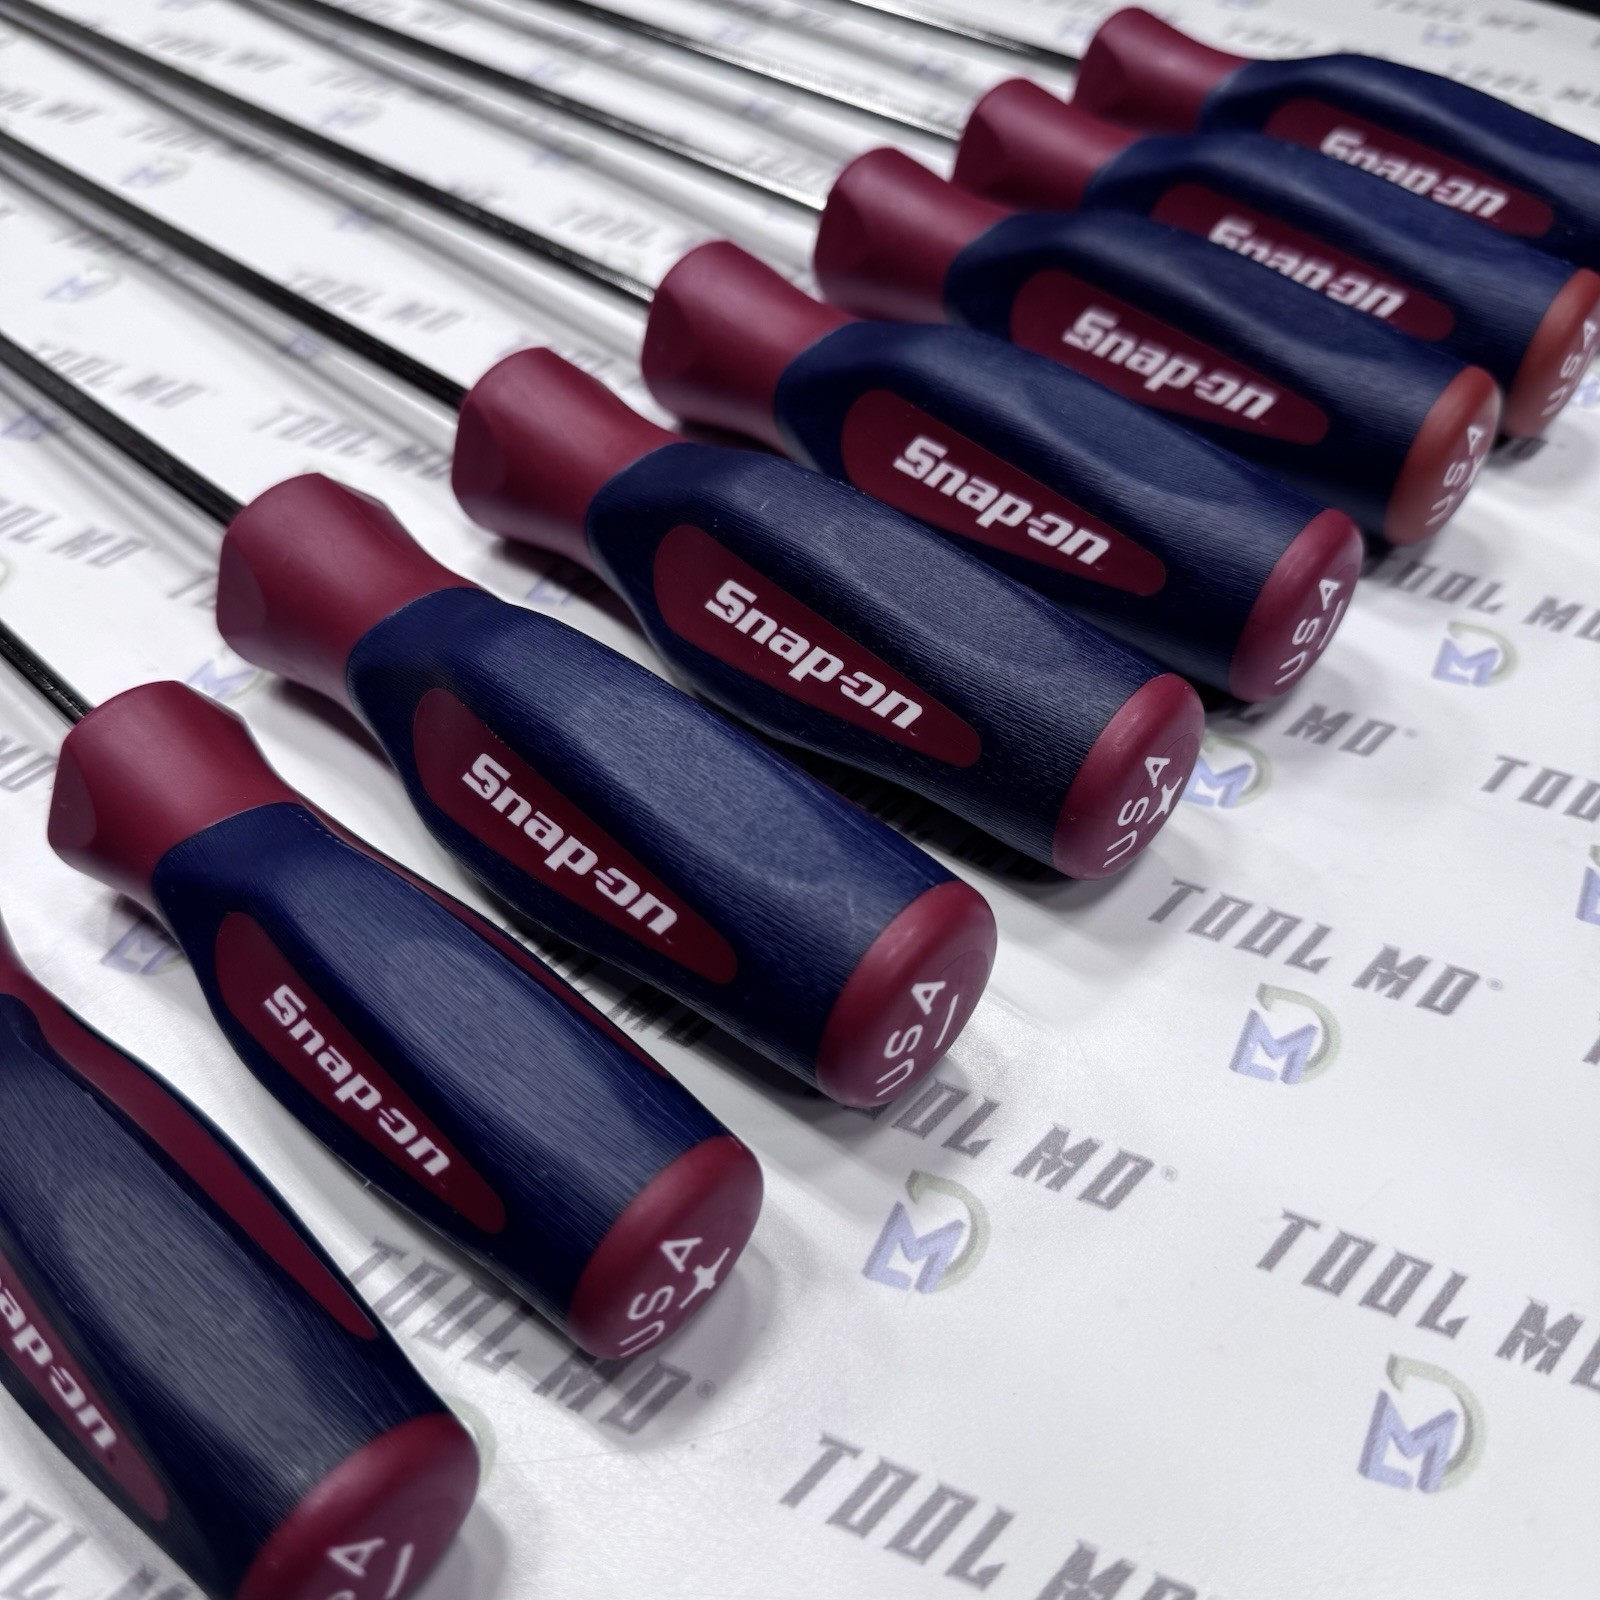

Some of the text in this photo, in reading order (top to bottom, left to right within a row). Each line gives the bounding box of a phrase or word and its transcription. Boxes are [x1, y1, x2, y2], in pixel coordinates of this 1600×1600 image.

[1062, 305, 1277, 419] Snap-on
[892, 434, 1110, 565] Snap-on
[1425, 425, 1487, 527] USA
[704, 579, 923, 730] Snap-on
[1274, 578, 1342, 686] USA
[461, 752, 678, 935] Snap-on
[1102, 756, 1171, 868] USA
[1147, 877, 1332, 975] TOOL
[263, 983, 451, 1177] Snap-on
[875, 980, 946, 1098] USA
[618, 1236, 703, 1358] USA
[1255, 1207, 1470, 1340] TOOL
[778, 1431, 1016, 1592] TOOL
